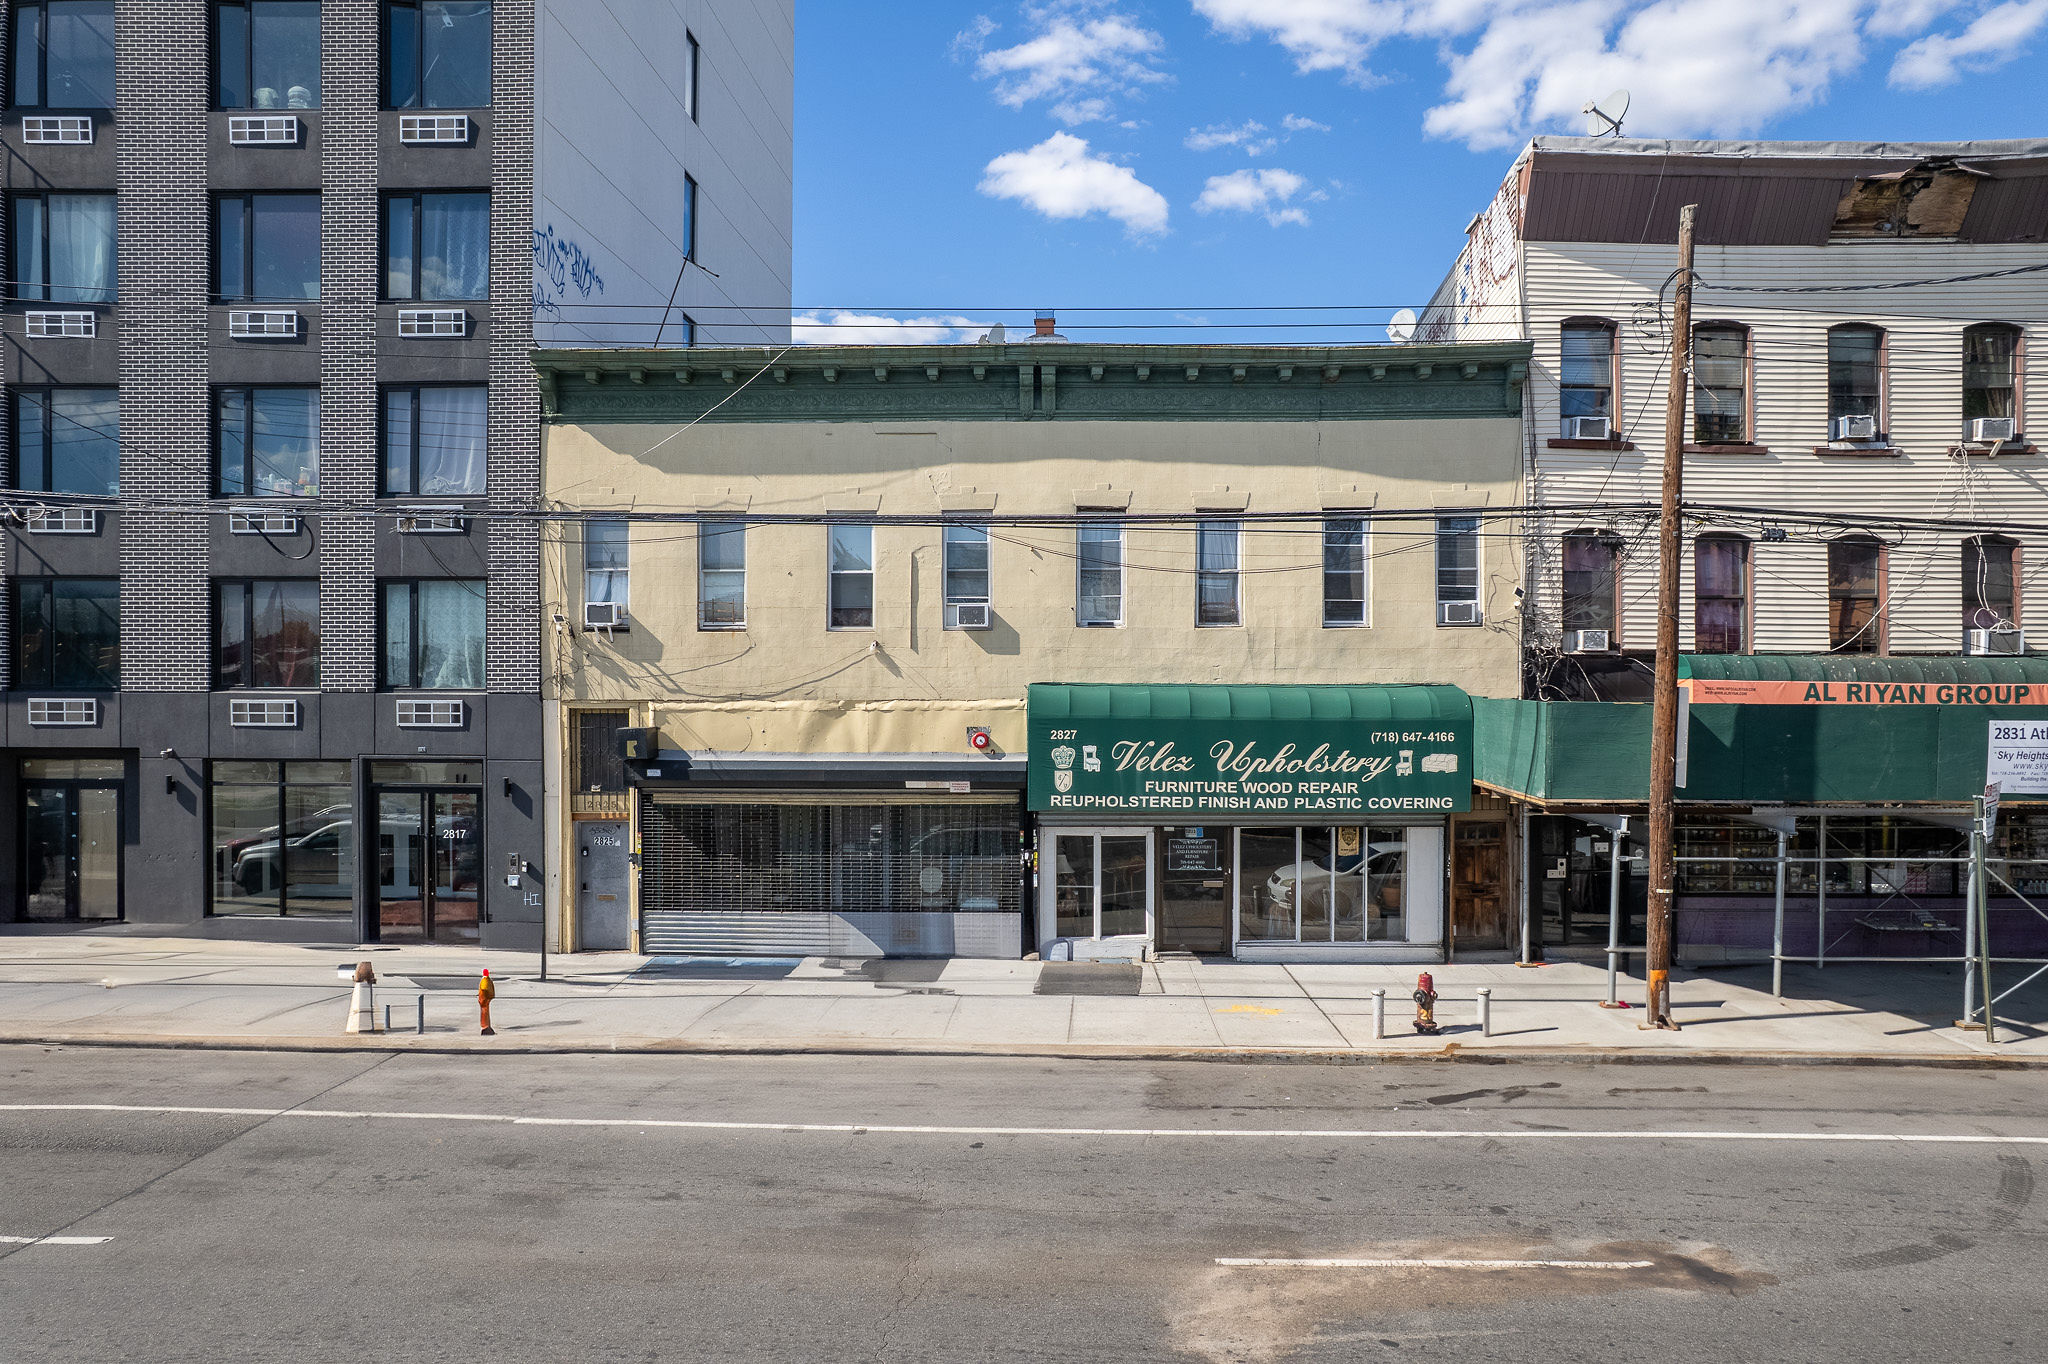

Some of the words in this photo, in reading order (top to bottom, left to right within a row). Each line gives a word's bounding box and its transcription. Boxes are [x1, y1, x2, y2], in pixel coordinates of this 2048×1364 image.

[1803, 683, 1837, 702] AL
[1847, 683, 1926, 704] RIYAN
[1936, 685, 2030, 704] GROUP
[1050, 730, 1077, 740] 2827
[1371, 731, 1399, 744] (718)
[1402, 732, 1455, 742] 647-4166
[1994, 727, 2026, 740] 2831
[1111, 740, 1195, 772] Velez
[1209, 739, 1392, 782] Upholstery
[1997, 750, 2014, 761] Sky
[2016, 750, 2048, 761] Heights
[1145, 781, 1238, 793] FURNITURE
[1242, 782, 1293, 794] WOOD
[1298, 782, 1359, 794] REPAIR
[1050, 795, 1194, 808] REUPHOLSTERED
[1198, 796, 1250, 809] FINISH
[1254, 797, 1289, 809] AND
[1294, 797, 1362, 809] PLASTIC
[1368, 797, 1453, 809] COVERING
[443, 829, 466, 839] 2817
[594, 836, 615, 846] 2825
[523, 891, 541, 906] HI
